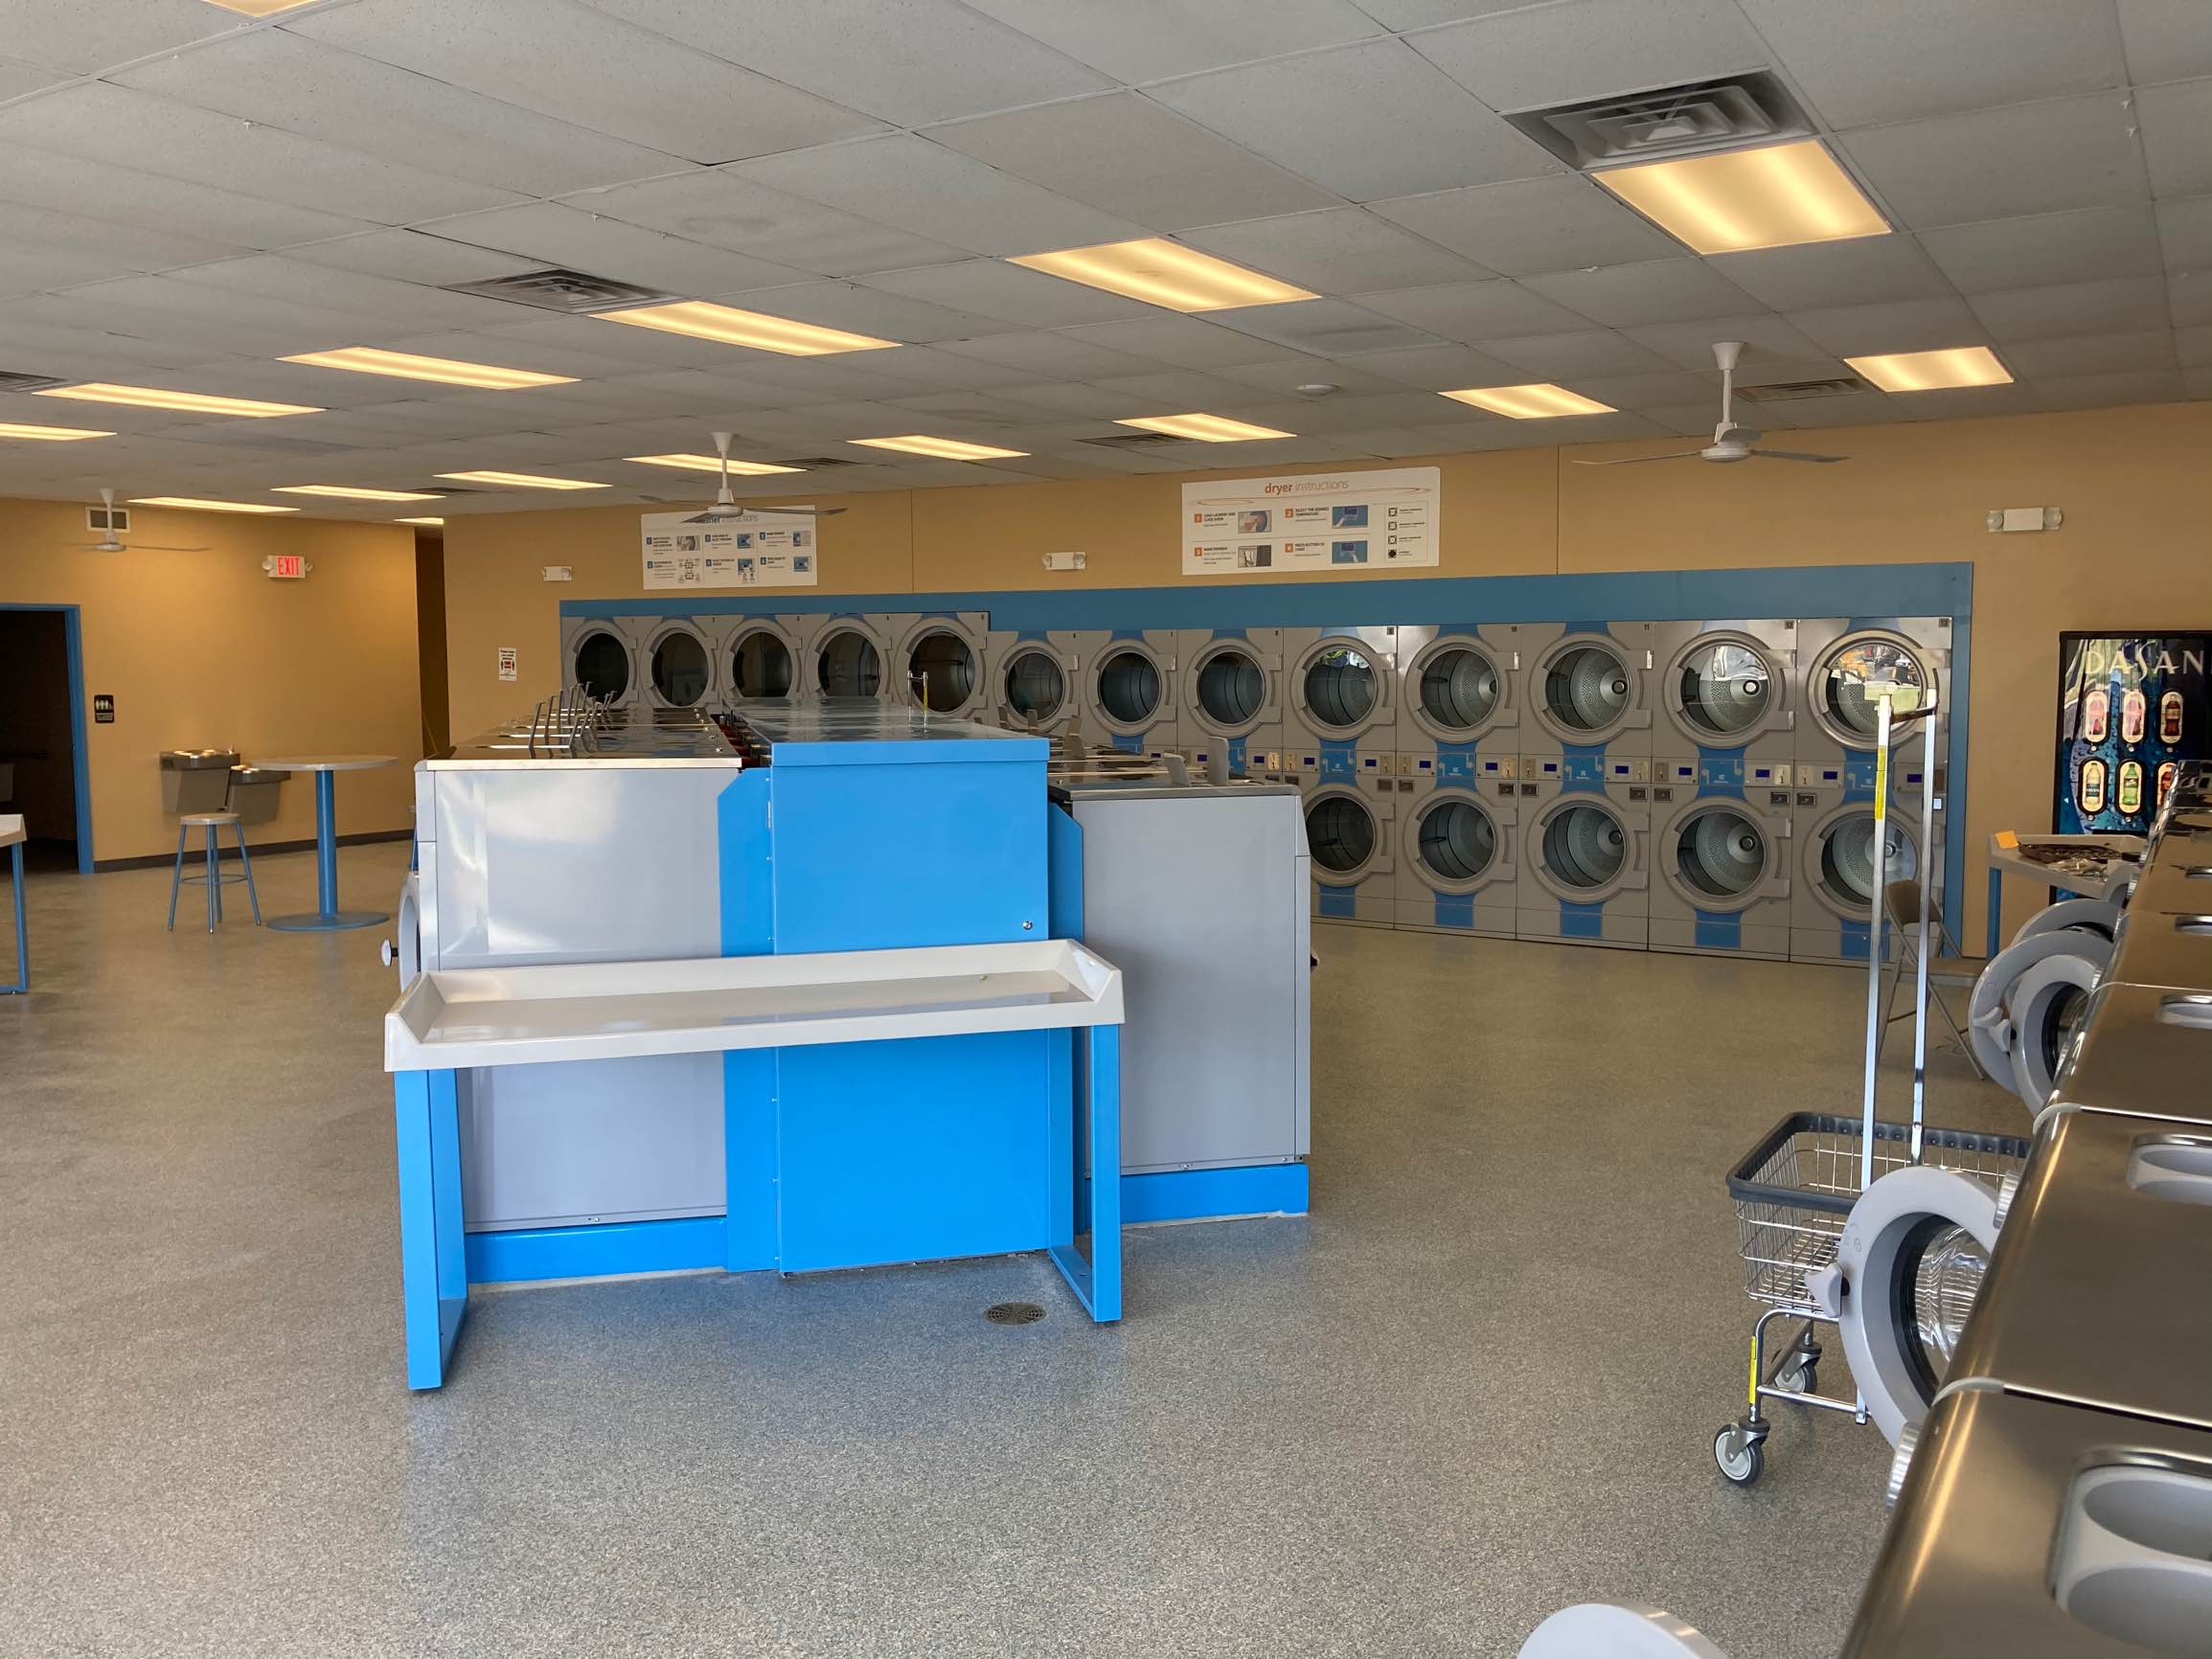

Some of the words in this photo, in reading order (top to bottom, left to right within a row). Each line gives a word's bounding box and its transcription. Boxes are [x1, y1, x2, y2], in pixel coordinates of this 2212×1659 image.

[1265, 483, 1293, 495] dryer
[1294, 480, 1349, 491] instructions
[278, 557, 300, 576] EXIT
[2085, 640, 2212, 681] DASAN
